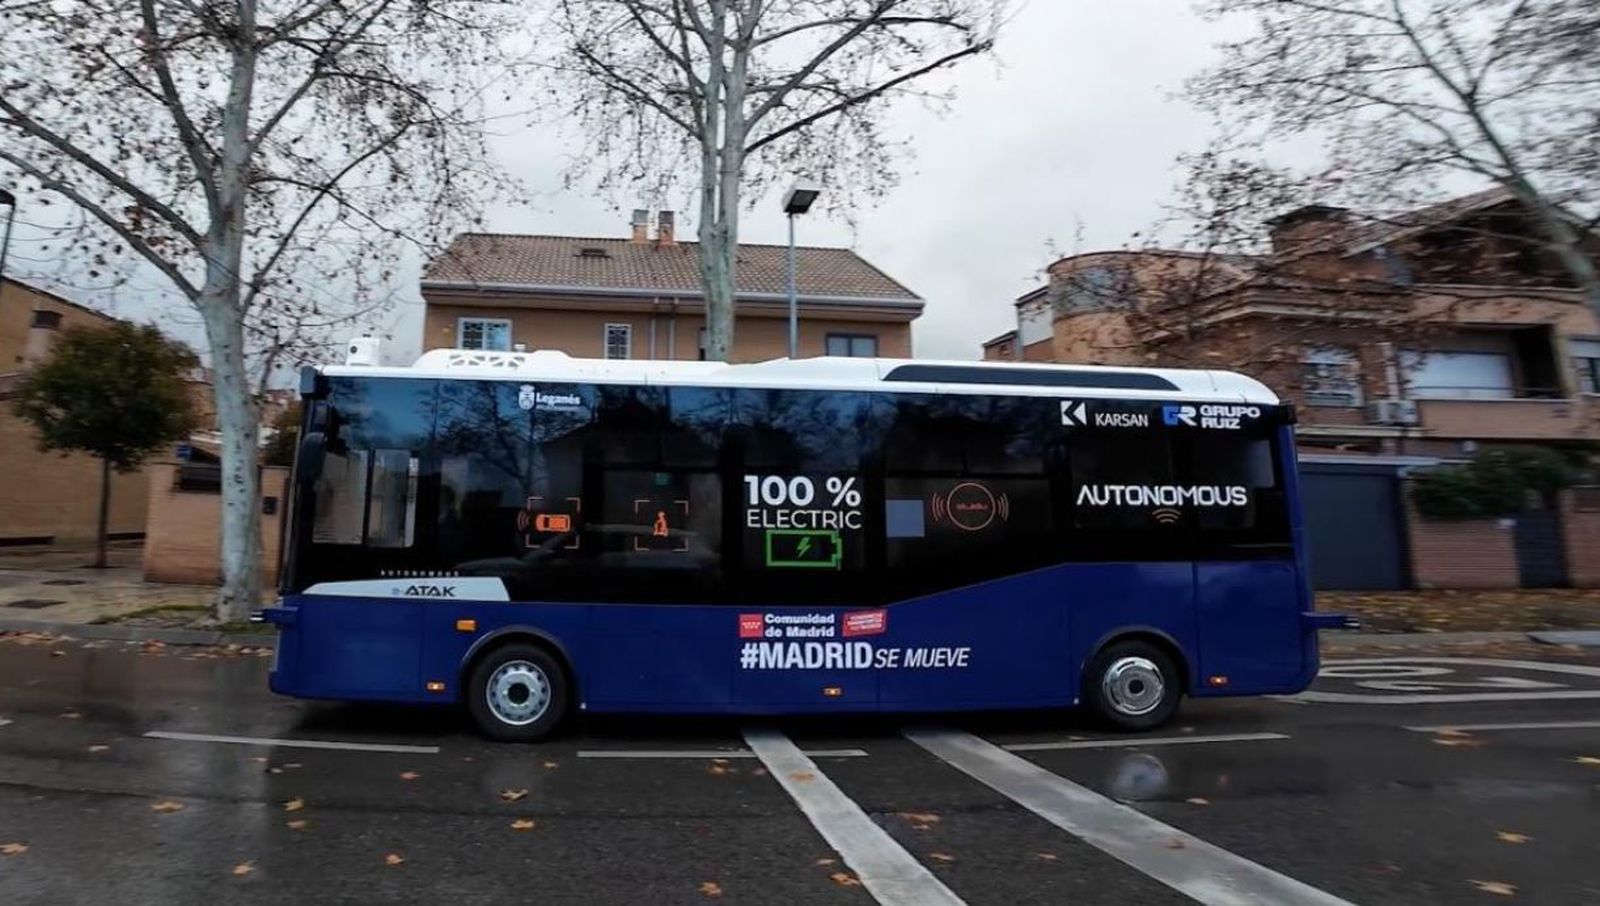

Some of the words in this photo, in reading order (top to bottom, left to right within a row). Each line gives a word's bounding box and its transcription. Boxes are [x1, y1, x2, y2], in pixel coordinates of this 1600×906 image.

[536, 392, 581, 406] Leganés
[1201, 405, 1261, 418] GRUPO
[1095, 413, 1149, 427] KARSAN
[1201, 418, 1241, 429] RUIZ
[744, 475, 815, 506] 100
[826, 476, 861, 507] %
[1077, 484, 1248, 506] AUTONOMOUS
[747, 509, 862, 529] ELECTRIC
[765, 614, 835, 624] Comunidad
[765, 626, 782, 637] de
[786, 626, 835, 637] Madrid
[740, 642, 873, 669] #MADRID
[874, 649, 900, 668] SE
[904, 648, 970, 667] MUEVE
